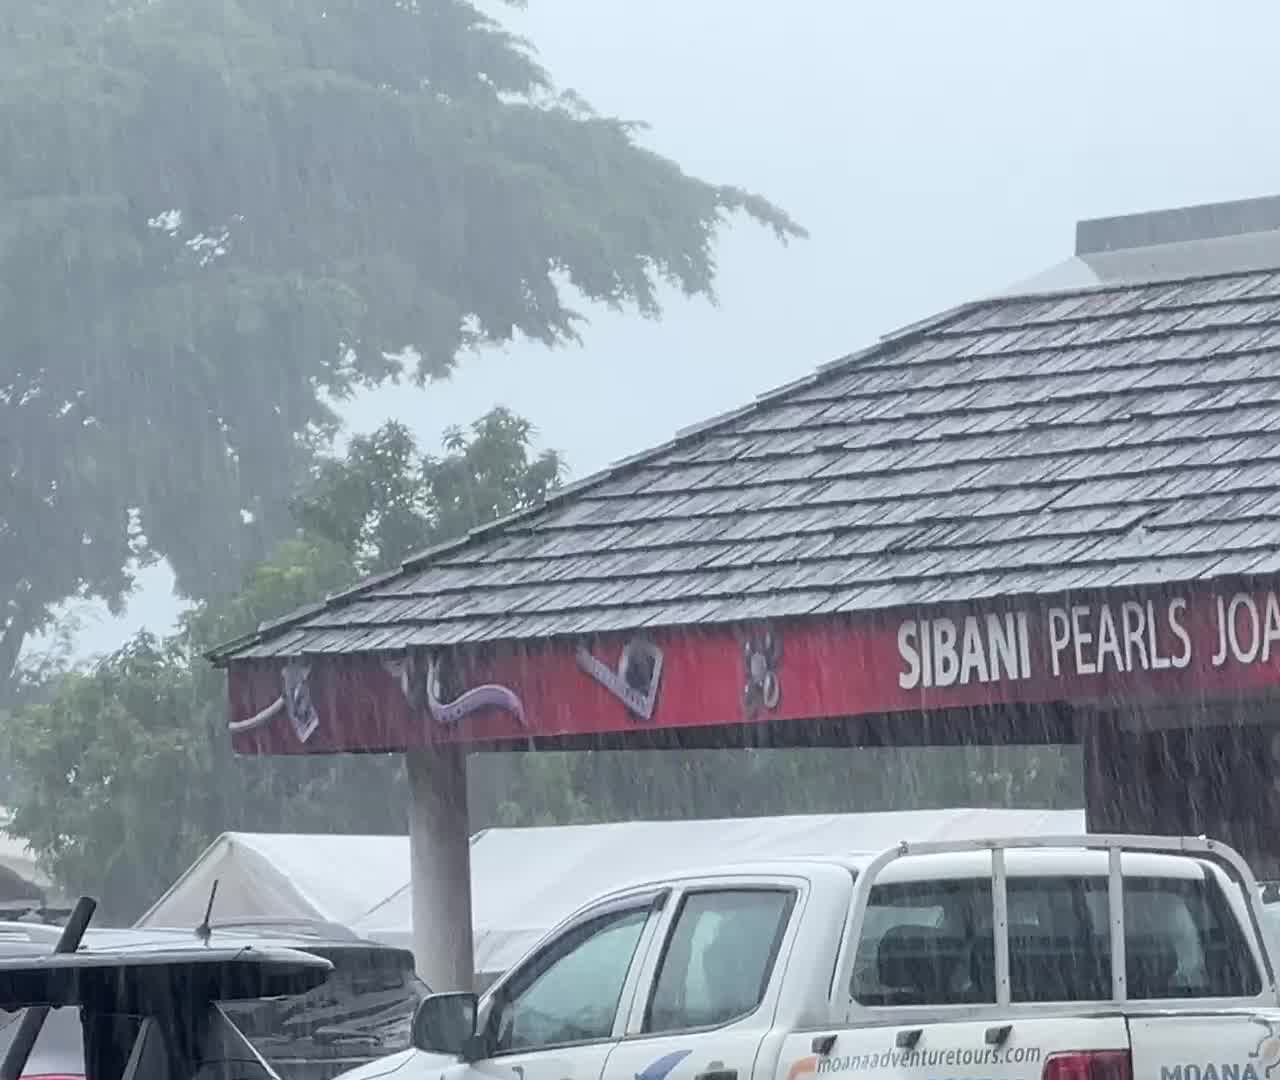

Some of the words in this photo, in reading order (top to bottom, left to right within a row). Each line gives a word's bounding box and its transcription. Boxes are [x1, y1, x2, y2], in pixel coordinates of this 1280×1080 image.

[897, 611, 1031, 690] SIBANI
[1048, 597, 1193, 677] PEARLS
[815, 1045, 1042, 1073] moanaadventuretours.com
